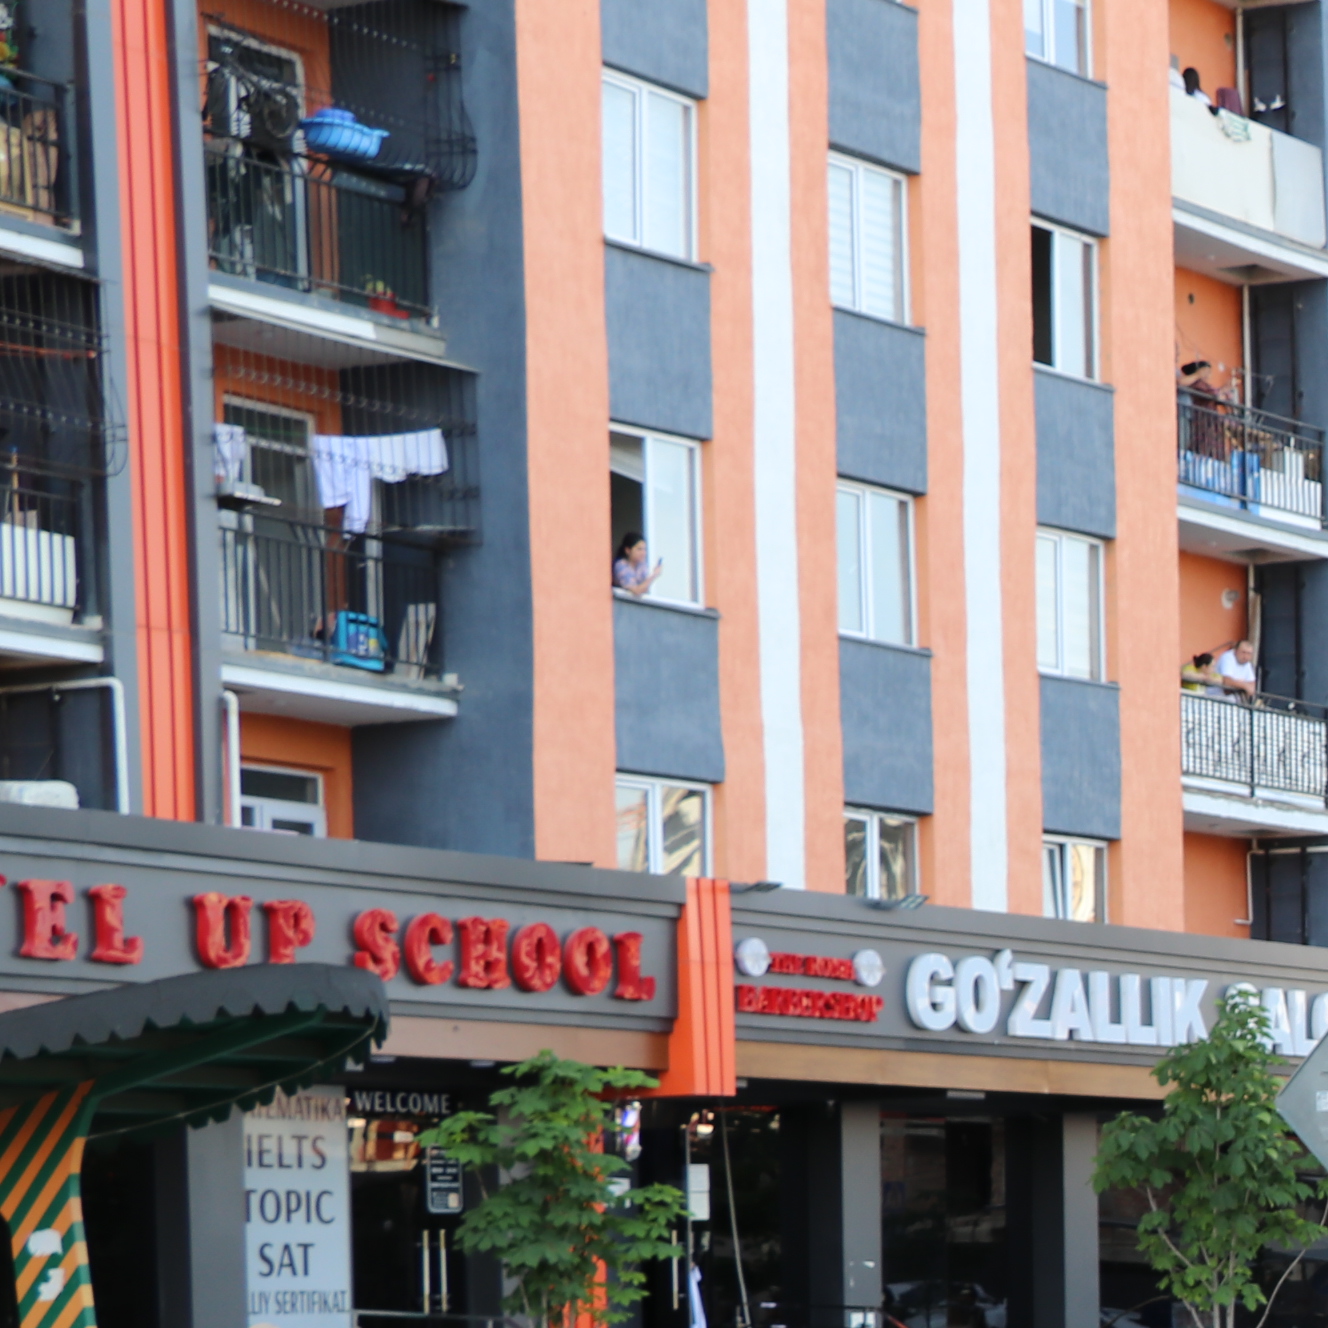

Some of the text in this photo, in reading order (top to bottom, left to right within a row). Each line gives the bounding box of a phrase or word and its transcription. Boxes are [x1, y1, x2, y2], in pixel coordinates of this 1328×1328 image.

[193, 892, 316, 969] UP
[354, 908, 656, 1000] SCHOOL
[354, 1090, 450, 1115] WELCOME
[246, 1134, 327, 1170] IELTS
[245, 1189, 335, 1224] TOPIC
[258, 1242, 315, 1278] SAT
